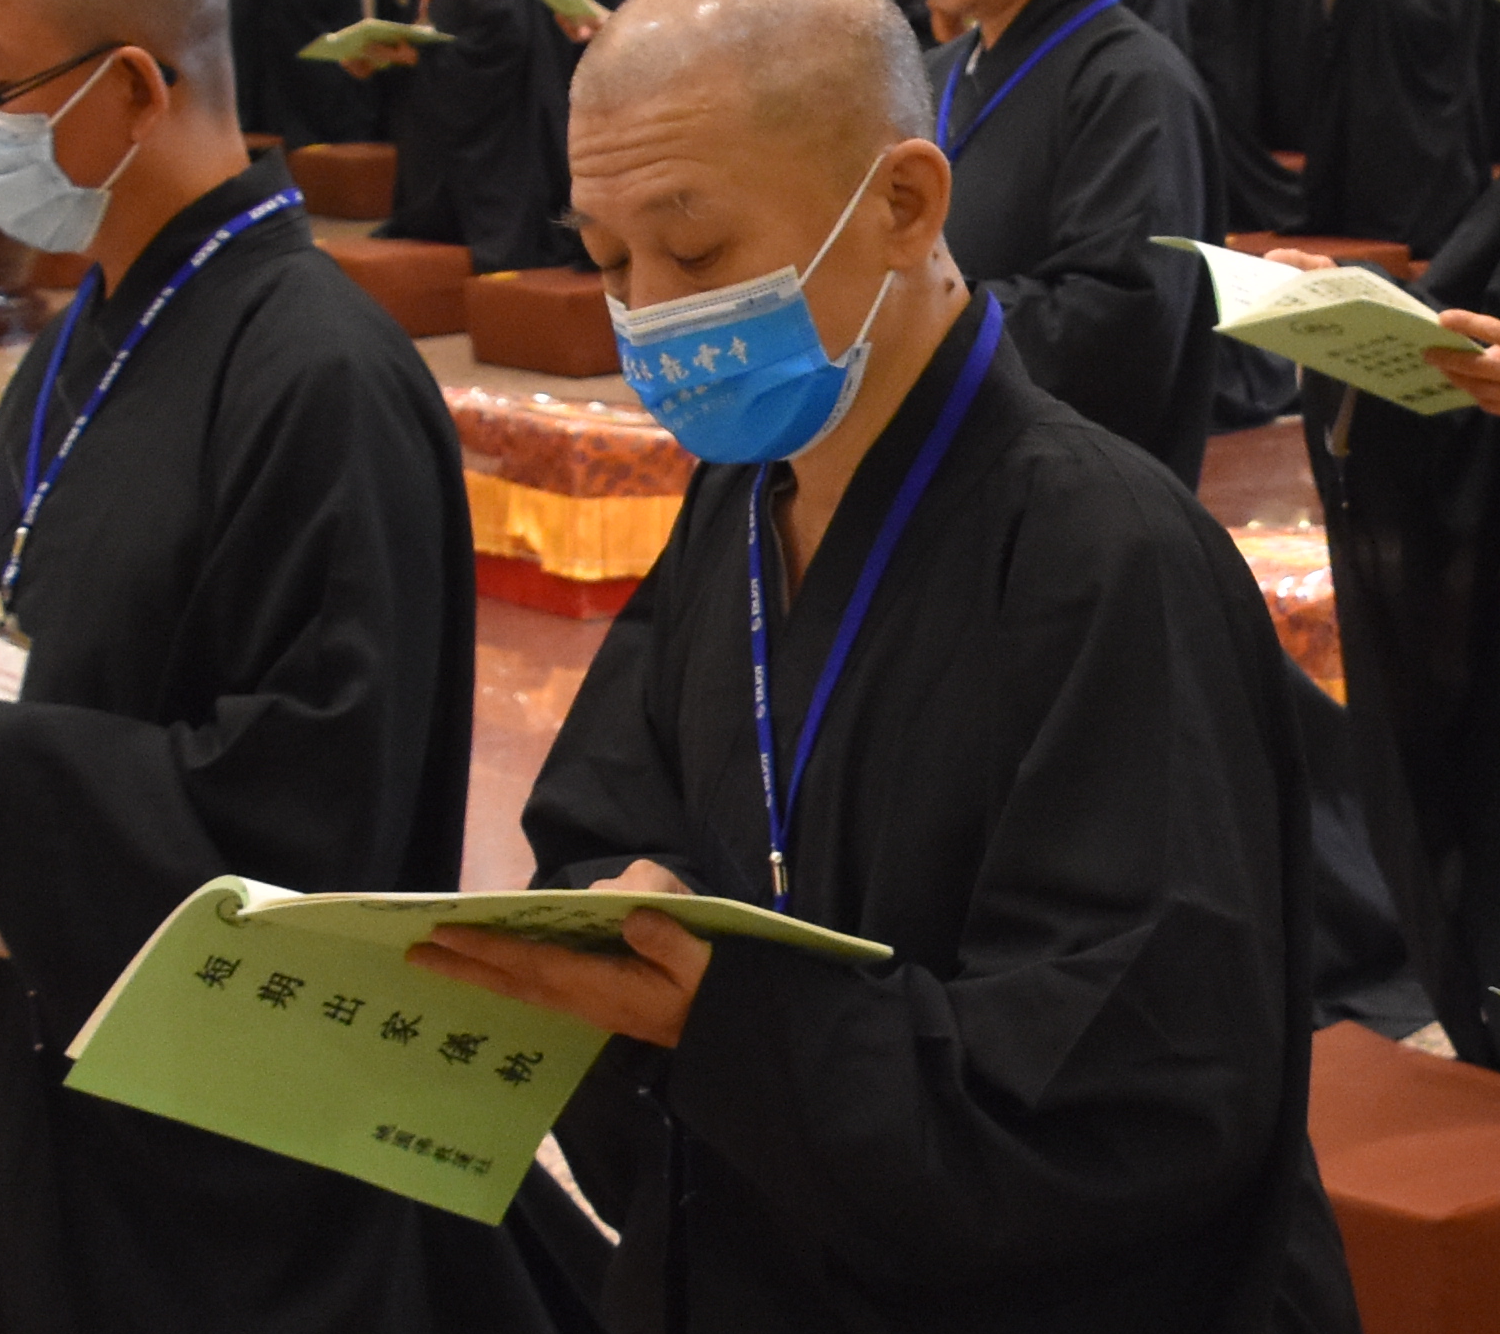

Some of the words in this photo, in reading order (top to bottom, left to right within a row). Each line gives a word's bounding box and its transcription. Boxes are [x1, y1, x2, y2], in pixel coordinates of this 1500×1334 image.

[195, 954, 544, 1087] 短期出家儀軌
